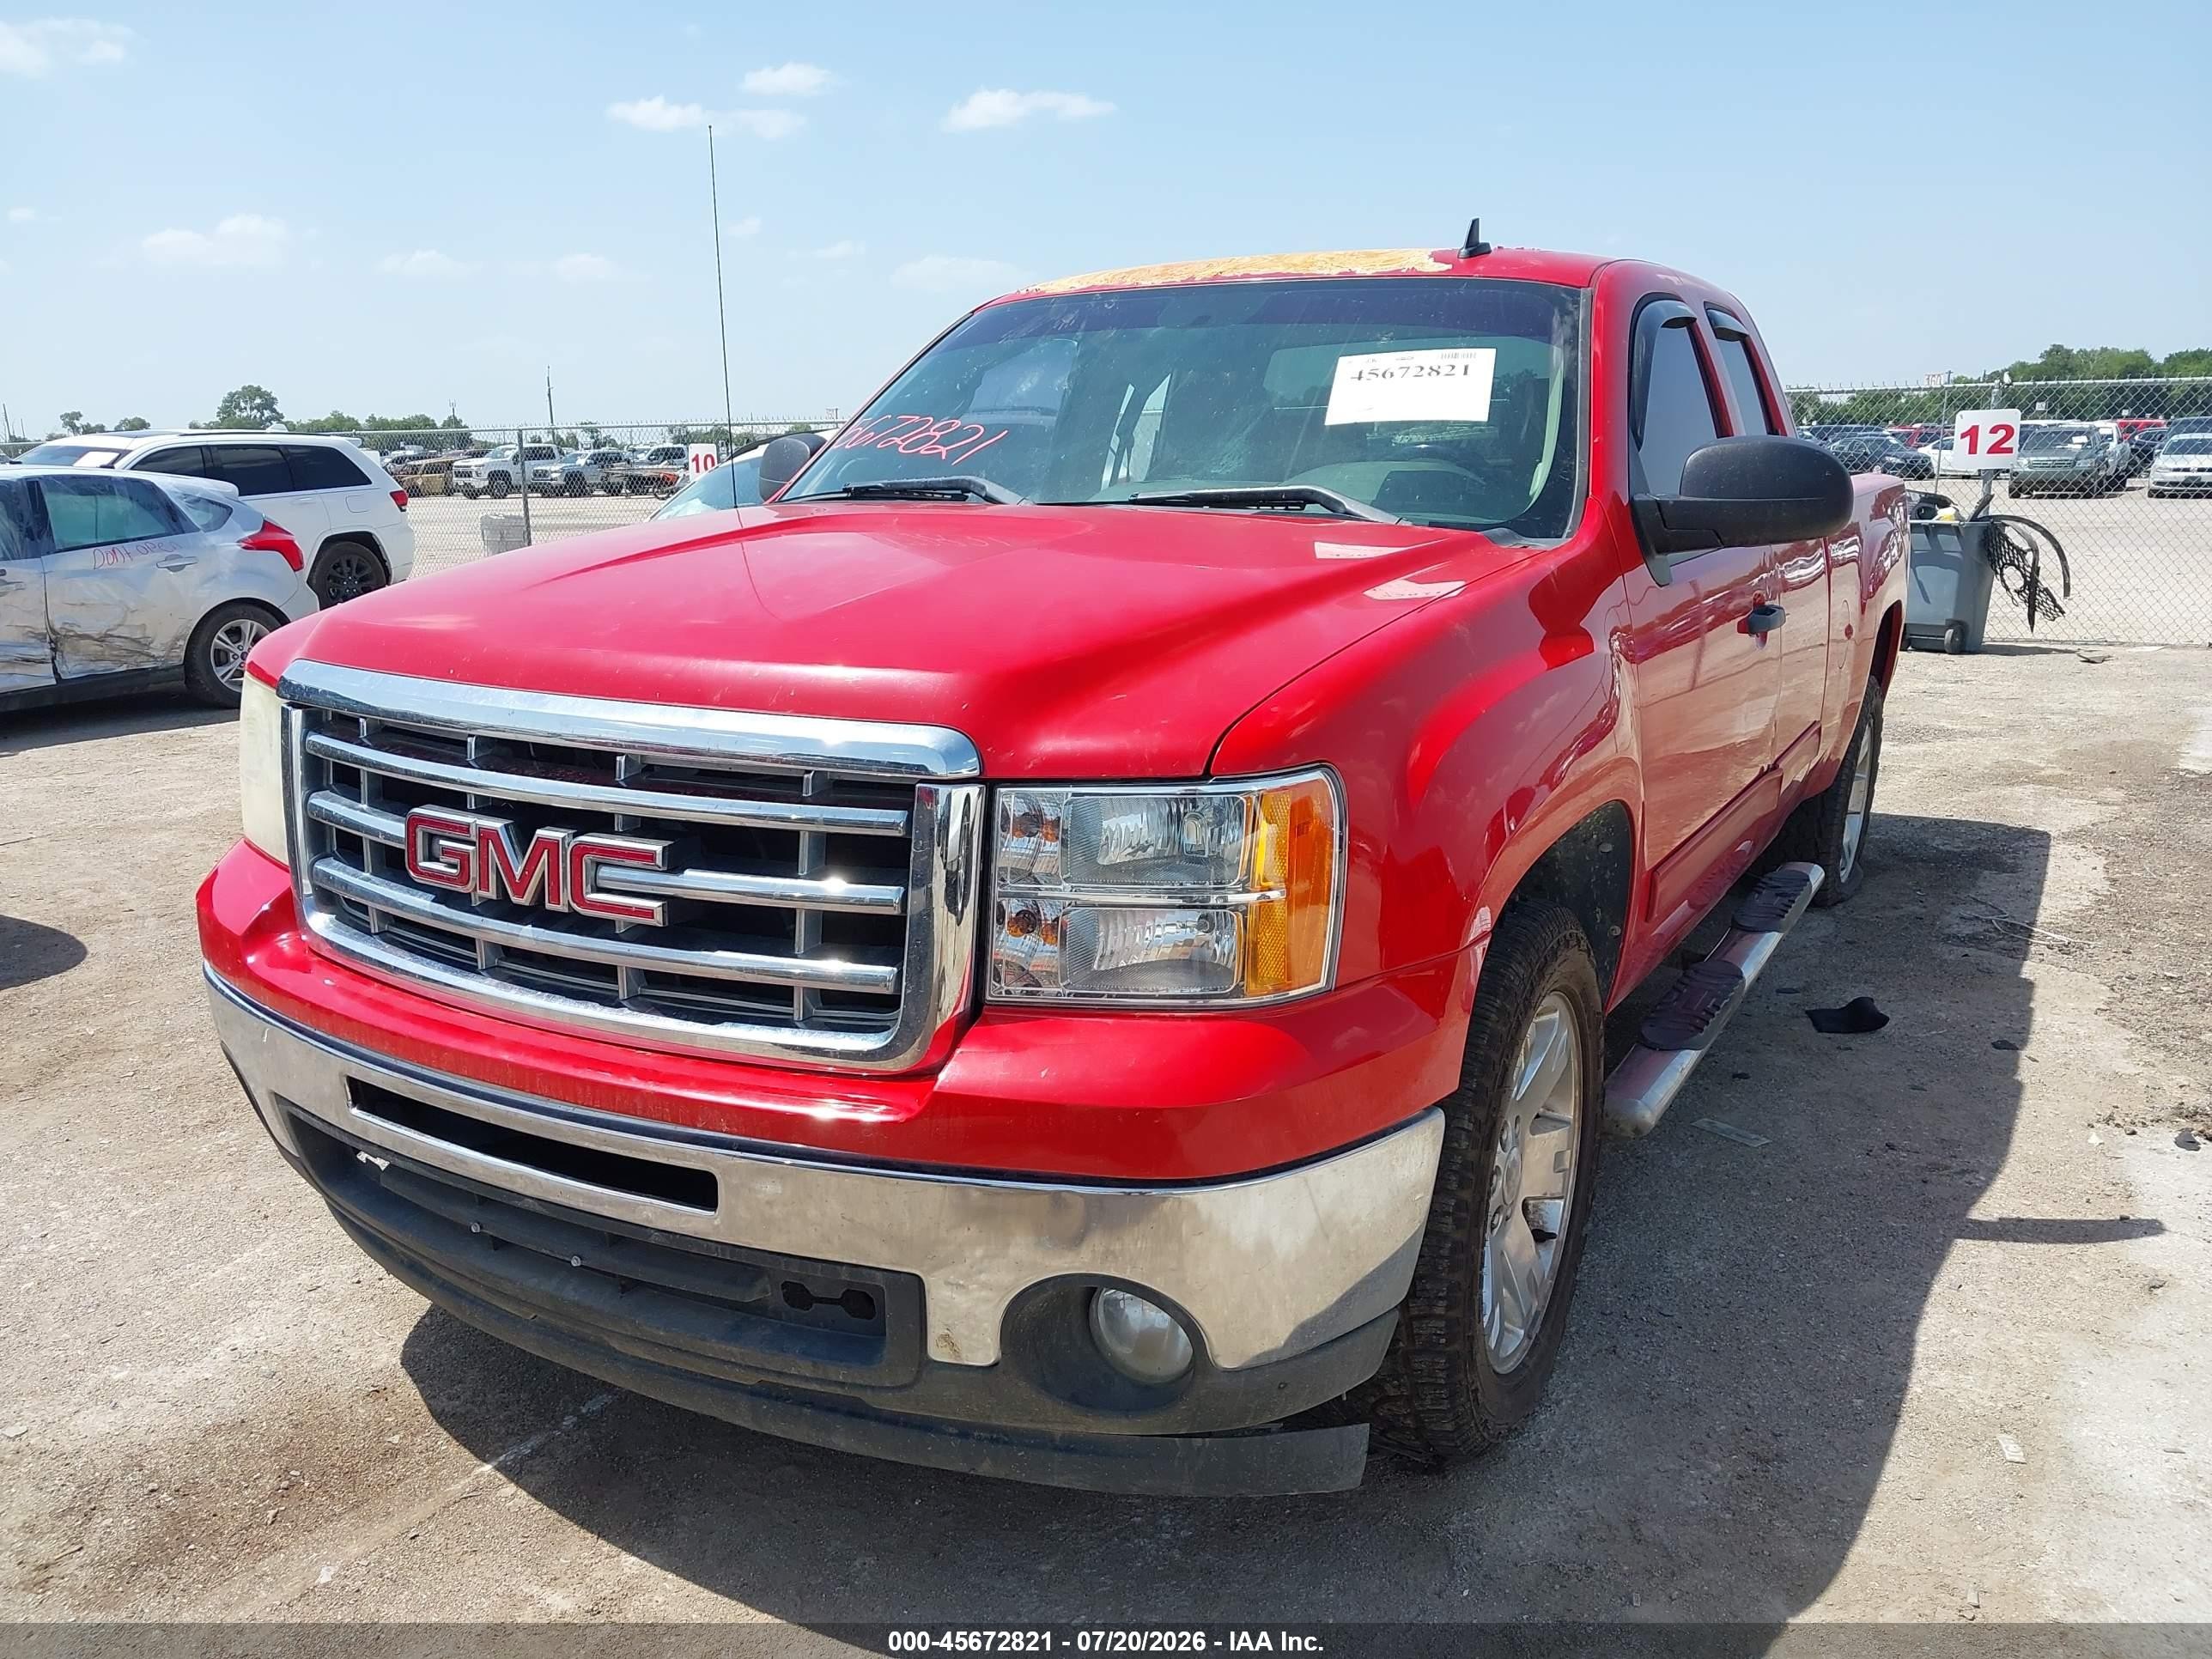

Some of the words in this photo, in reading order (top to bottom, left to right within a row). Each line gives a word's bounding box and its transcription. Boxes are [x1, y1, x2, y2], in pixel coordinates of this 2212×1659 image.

[1350, 363, 1469, 381] 45672821
[1960, 423, 2014, 456] 12
[691, 453, 715, 473] 10
[404, 805, 671, 927] GMC
